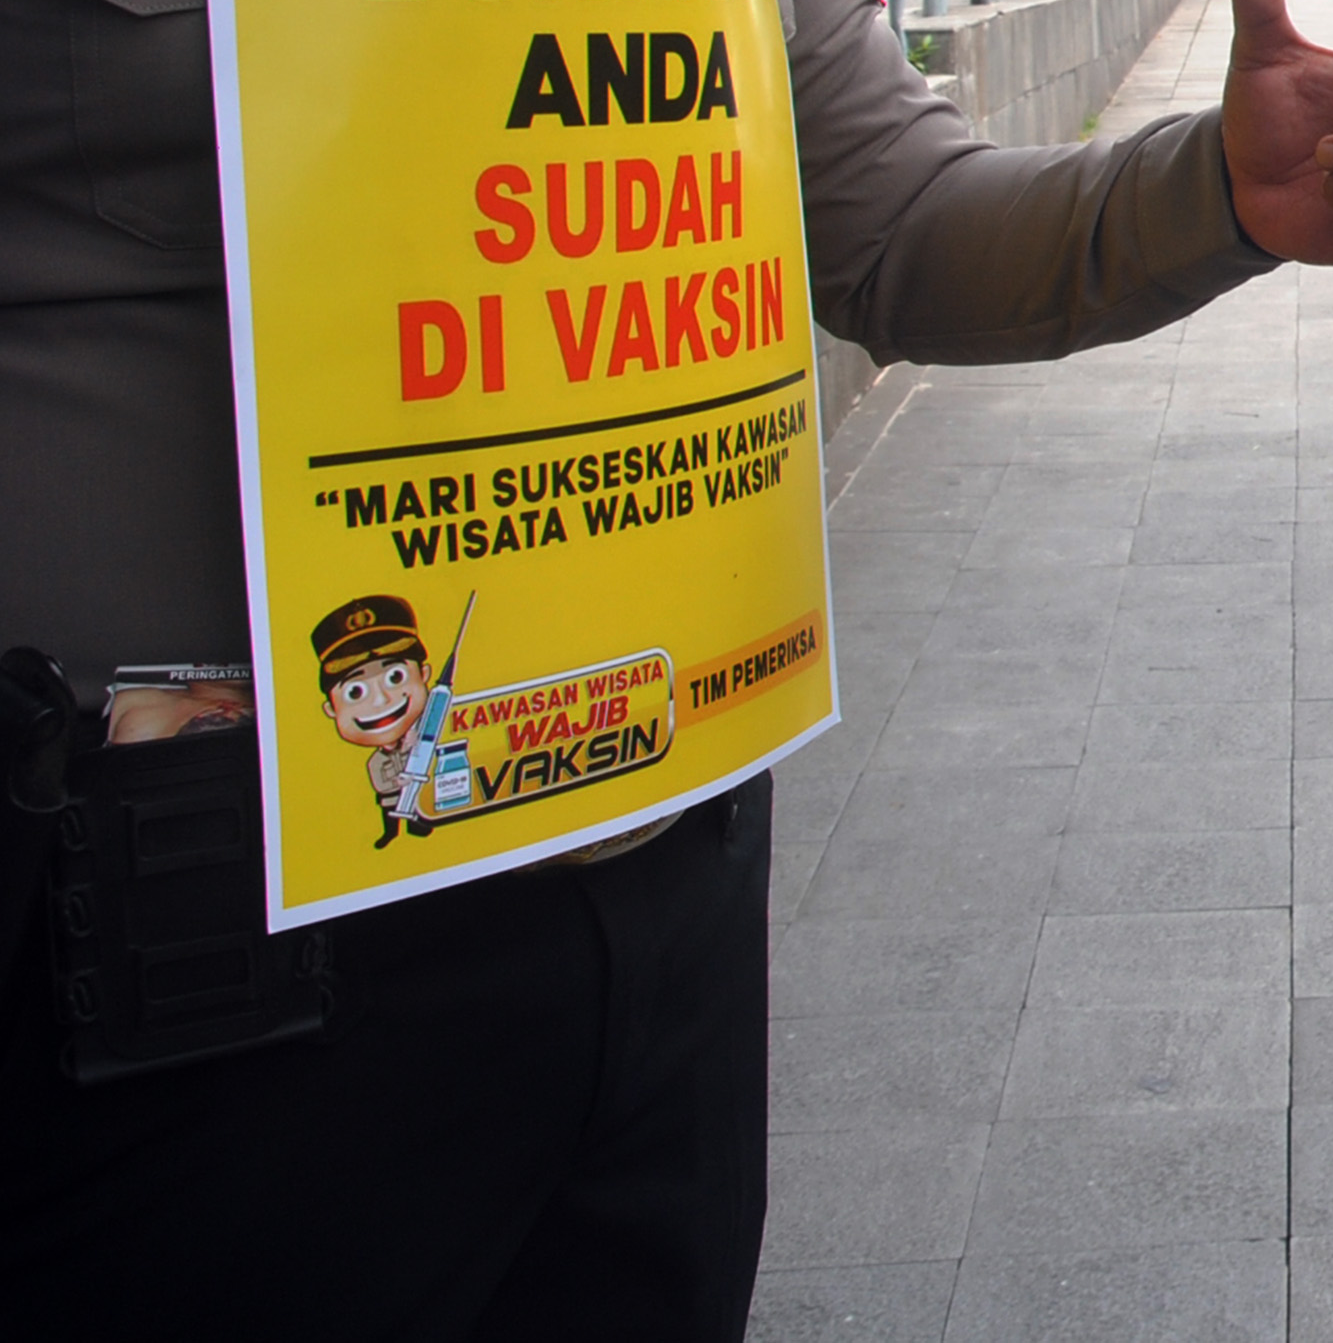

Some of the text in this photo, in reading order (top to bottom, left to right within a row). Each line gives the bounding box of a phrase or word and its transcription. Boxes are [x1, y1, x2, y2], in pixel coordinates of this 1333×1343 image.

[505, 31, 739, 130] ANDA
[474, 150, 743, 265] SUDAH
[398, 256, 785, 403] DI VAKSIN
[315, 399, 807, 529] “MARI SUKSESKAN KAWASAN
[391, 506, 568, 569] WISATA
[581, 478, 695, 537] WAJIB
[169, 669, 249, 681] PERINGATAN
[452, 659, 664, 733] KAWASAN WISATA
[690, 625, 816, 709] TIM PEMERIKSA
[475, 717, 660, 801] VAKSIN
[507, 695, 630, 753] WAJIB
